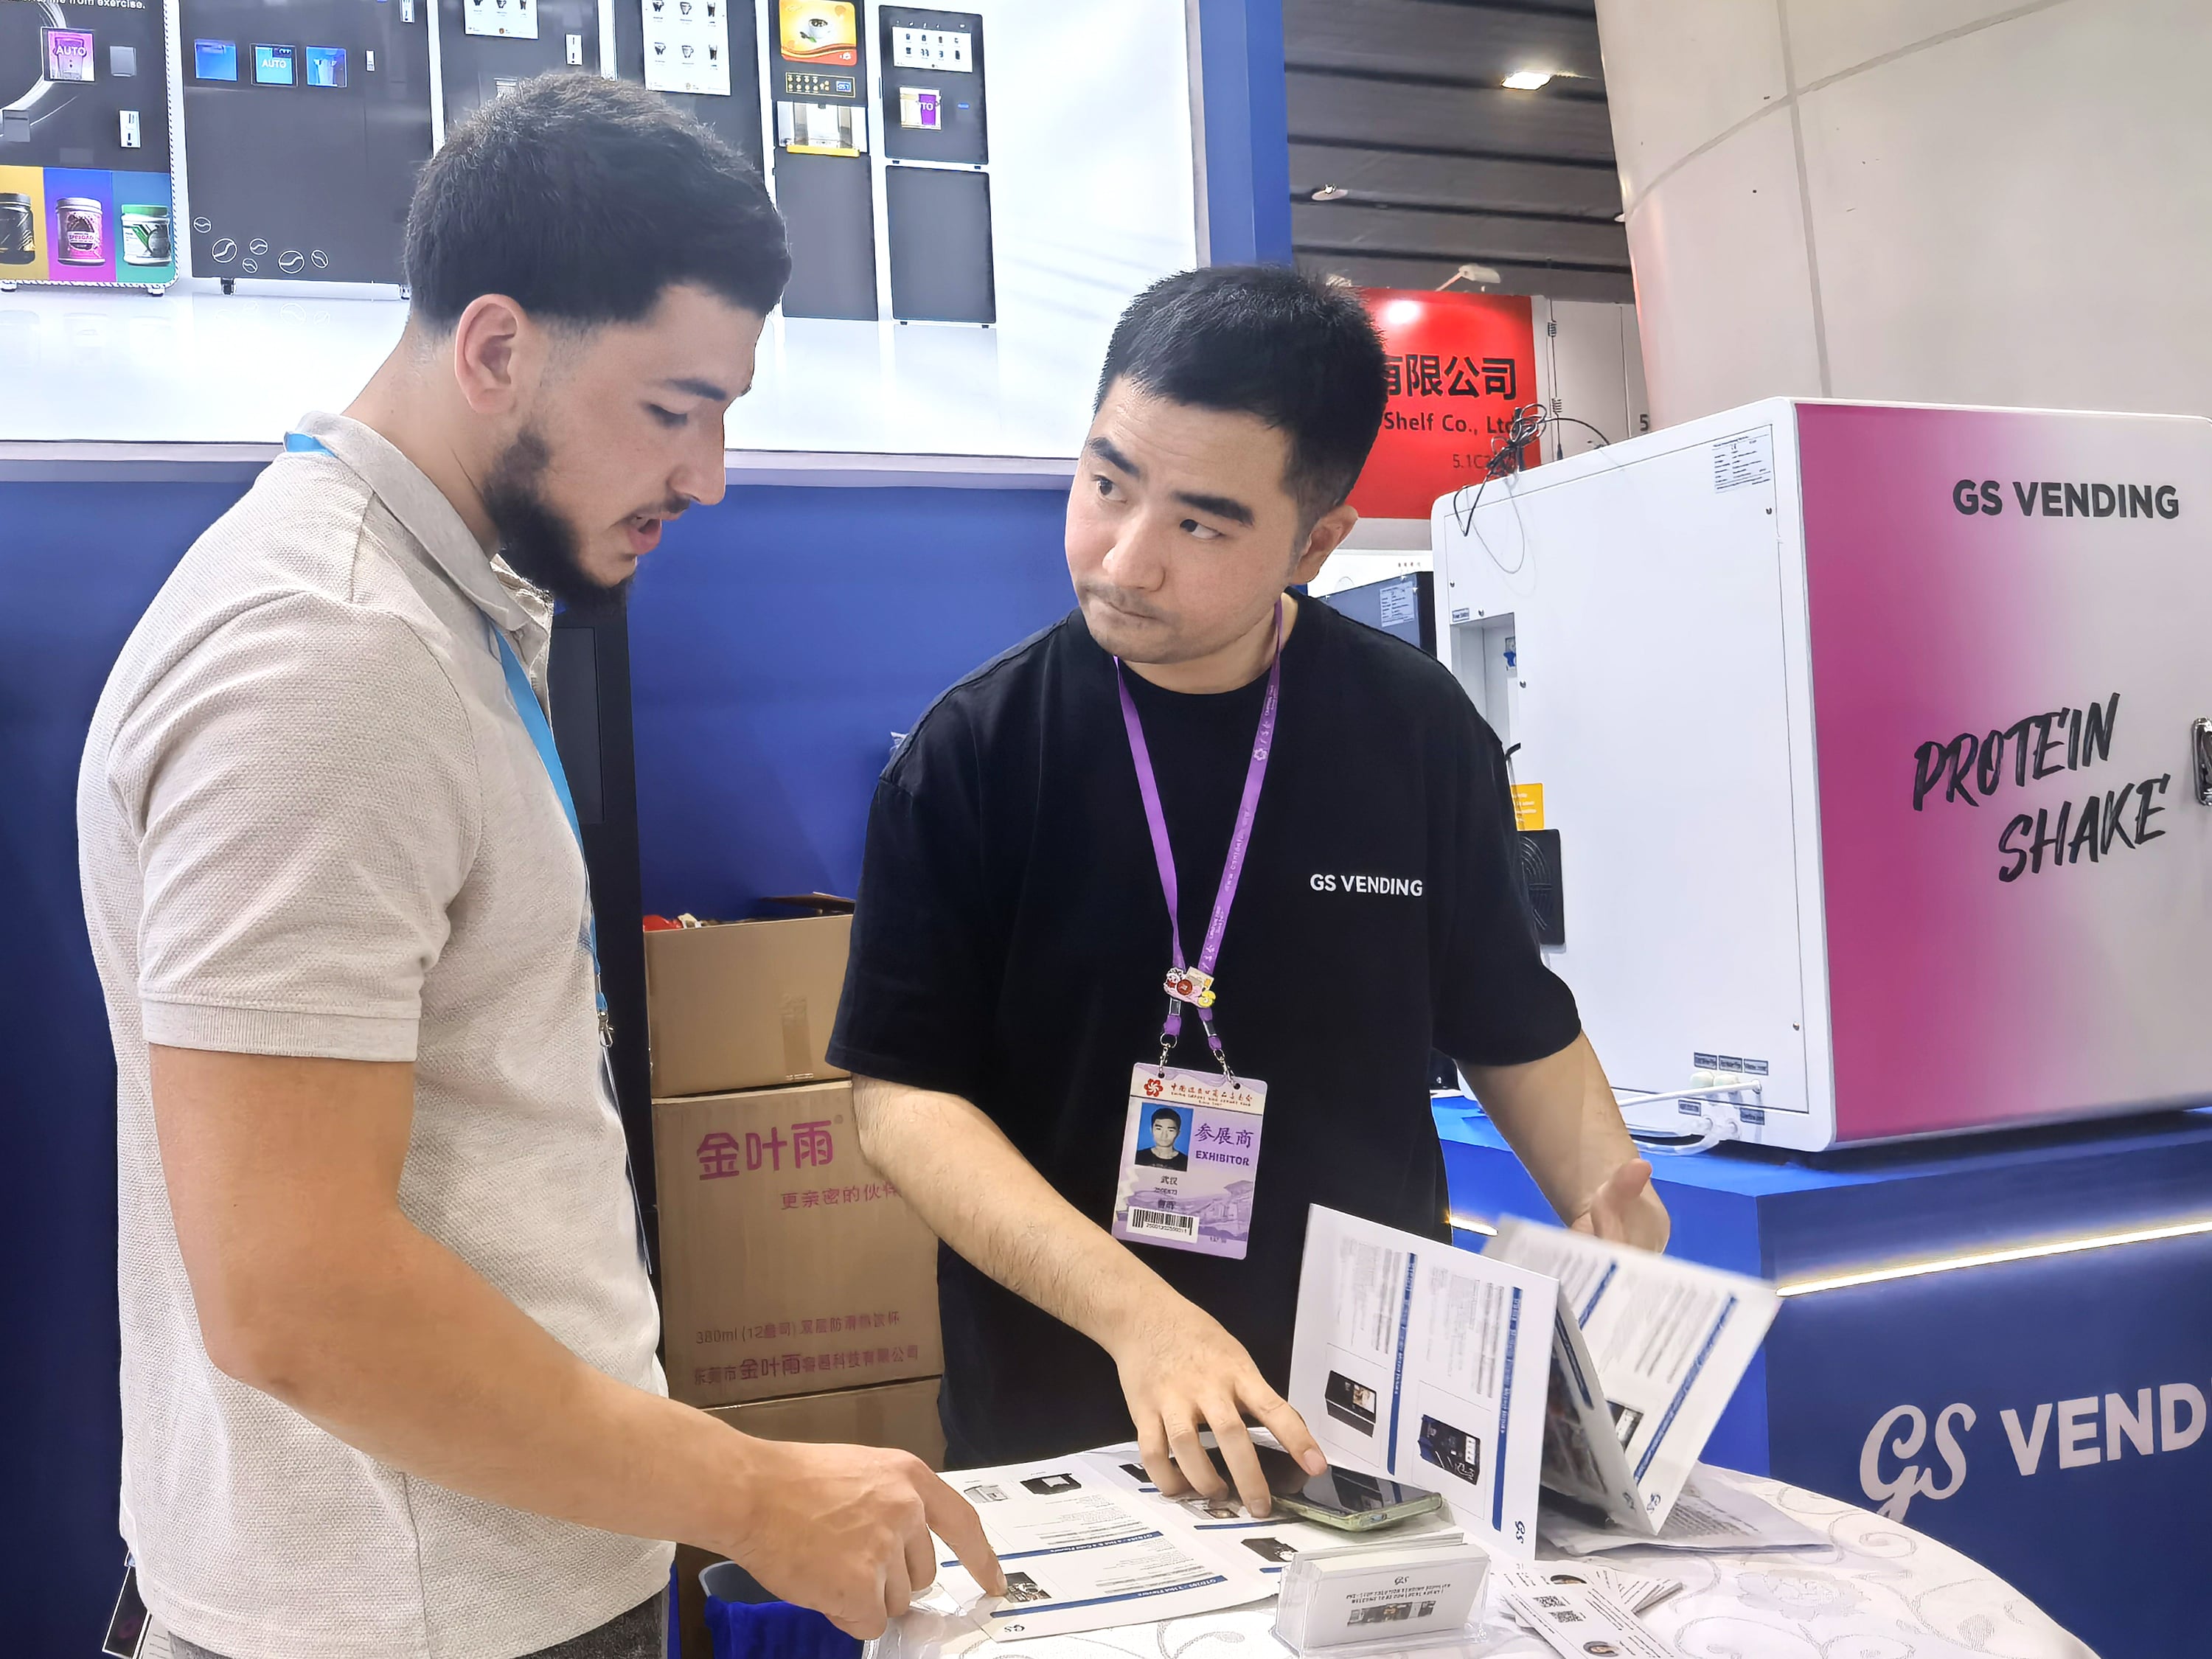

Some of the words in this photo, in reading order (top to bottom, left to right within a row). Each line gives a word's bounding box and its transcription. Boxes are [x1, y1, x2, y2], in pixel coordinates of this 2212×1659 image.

[98, 0, 146, 9] exercise.
[55, 45, 87, 57] AUTO
[262, 59, 288, 69] AUTO
[1384, 411, 1434, 431] Shelf
[1442, 414, 1478, 435] Co.,
[1952, 479, 2003, 516] GS
[2012, 481, 2180, 519] VENDING
[1913, 692, 2121, 812] PROTEIN
[1998, 773, 2171, 883] SHAKE
[1310, 874, 1337, 892] GS
[1340, 875, 1423, 897] VENDING
[1194, 1123, 1254, 1149] 参展商
[696, 1119, 834, 1180] 金叶雨
[1195, 1150, 1250, 1166] EXHIBITOR
[1860, 1402, 1977, 1523] GS
[2000, 1377, 2212, 1476] VEND
